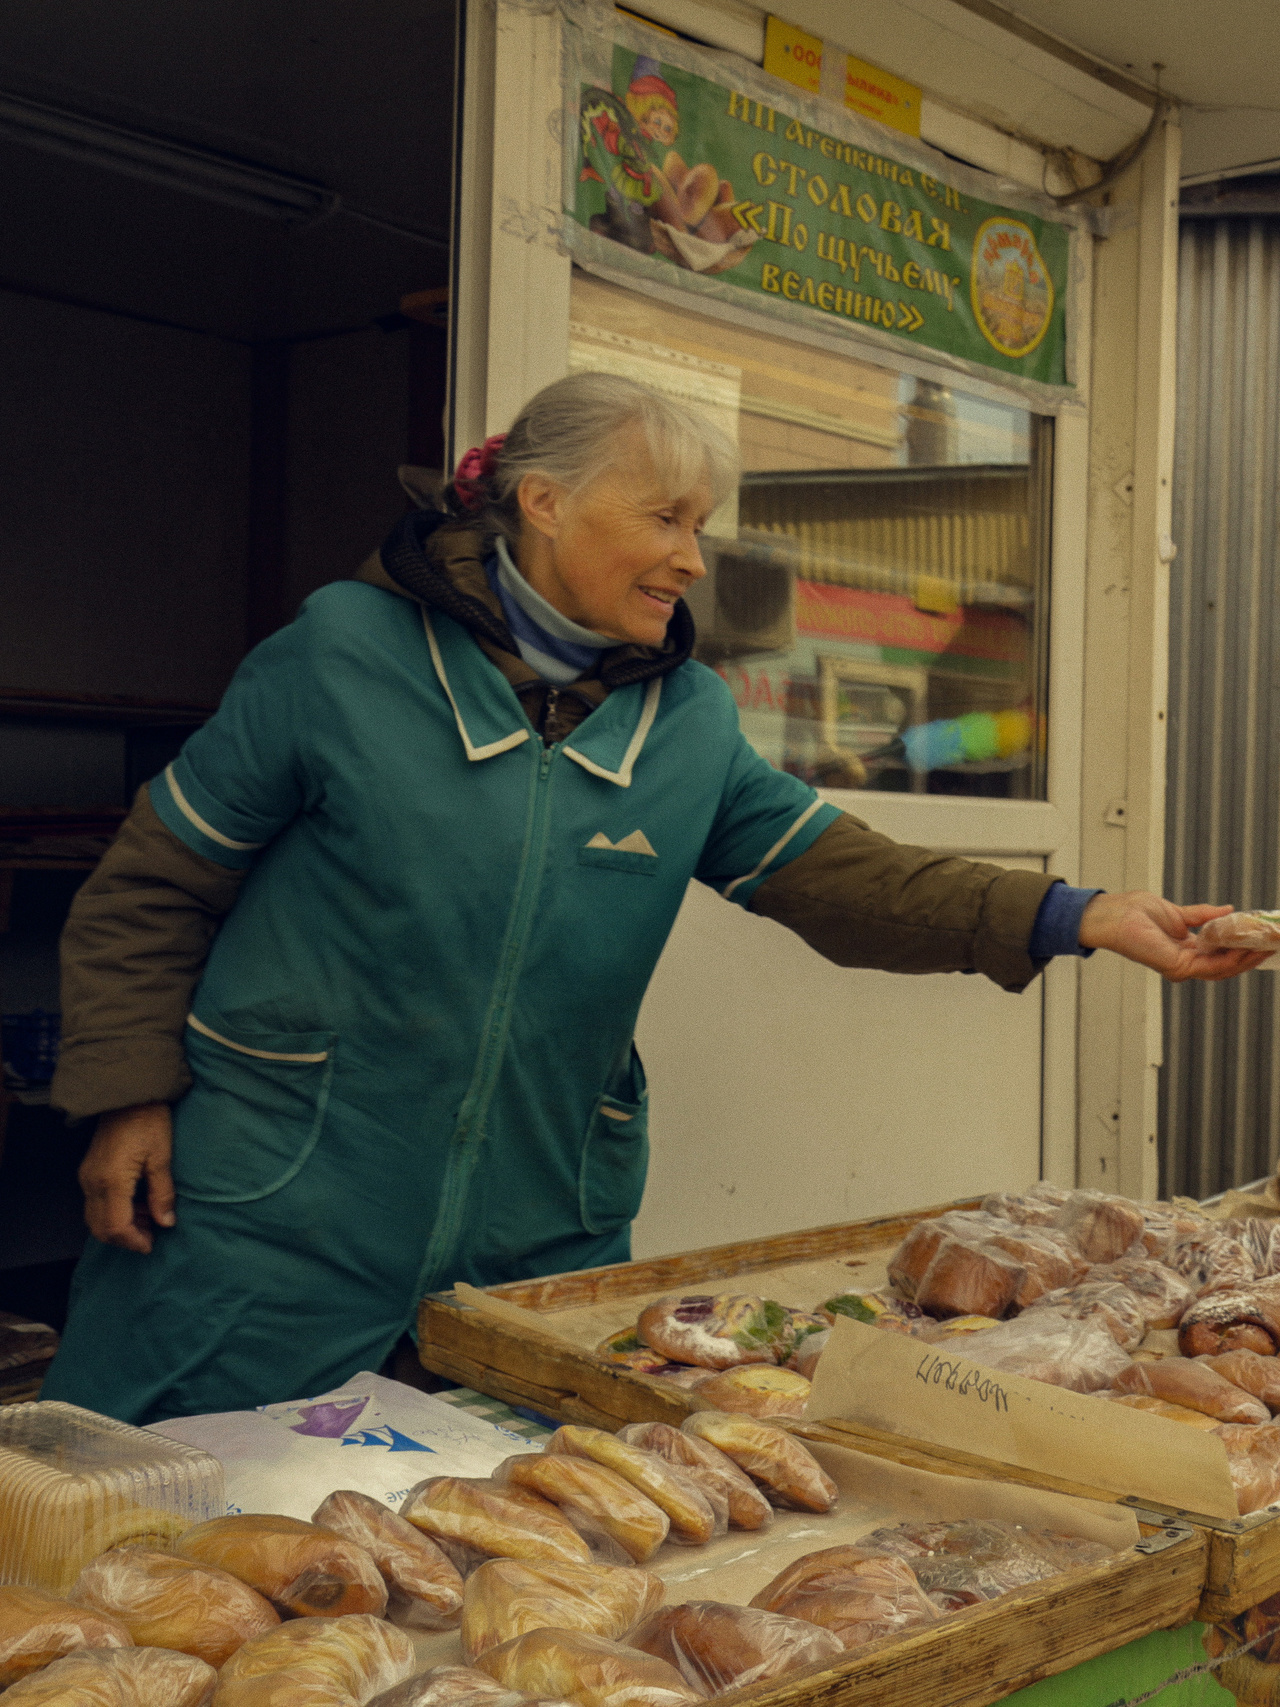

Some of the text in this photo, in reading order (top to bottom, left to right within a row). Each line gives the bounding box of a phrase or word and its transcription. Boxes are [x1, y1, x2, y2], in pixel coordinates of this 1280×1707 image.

[727, 90, 776, 133] ИП
[731, 200, 960, 313] «По щучьему
[761, 263, 925, 332] велению»
